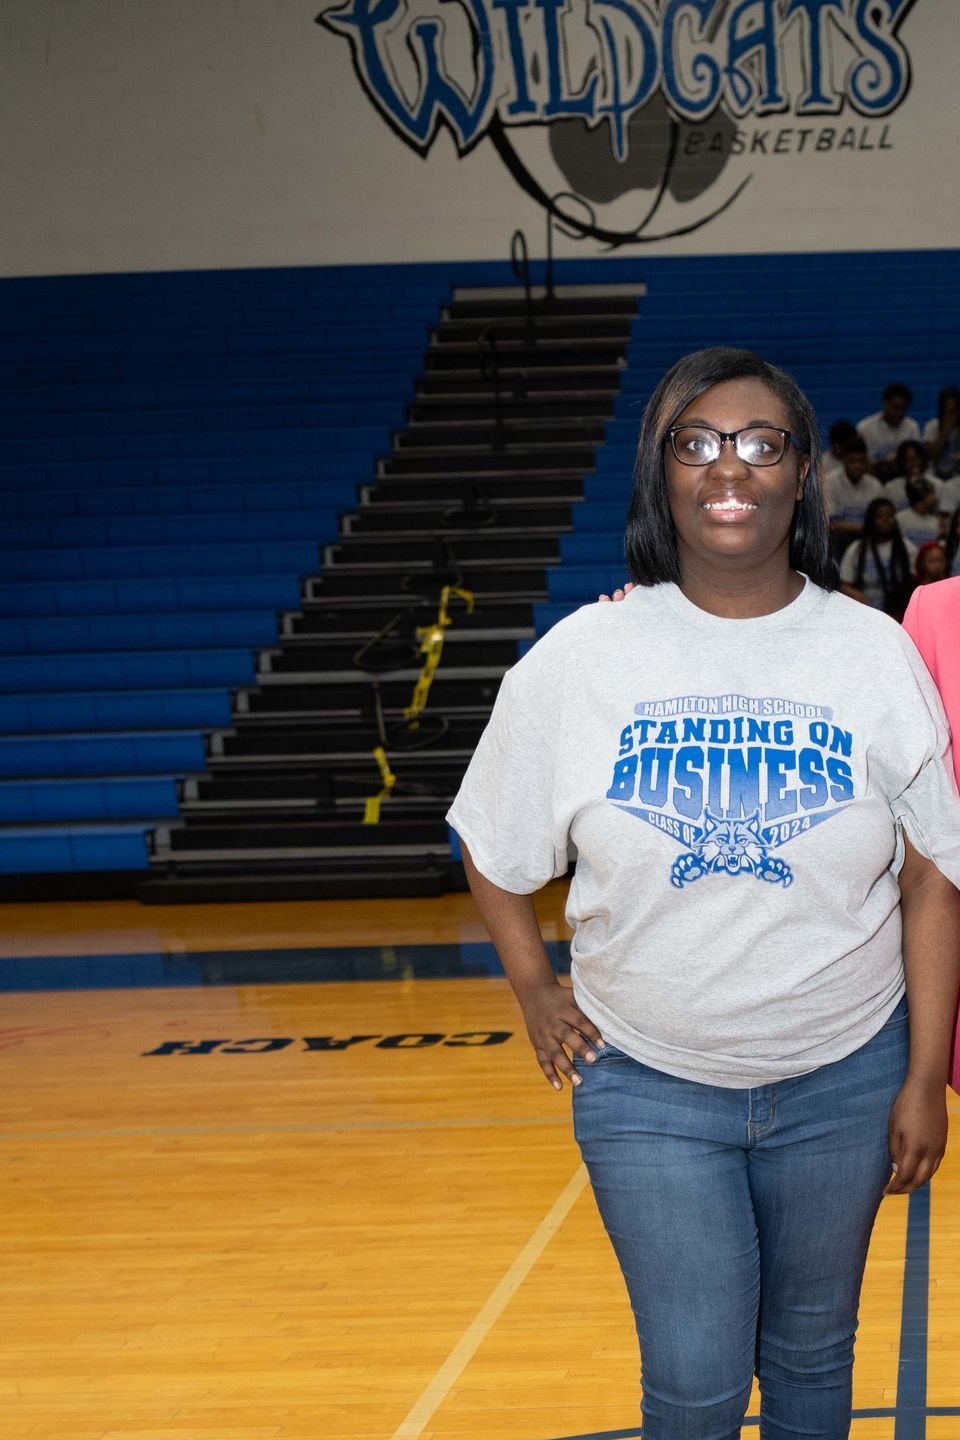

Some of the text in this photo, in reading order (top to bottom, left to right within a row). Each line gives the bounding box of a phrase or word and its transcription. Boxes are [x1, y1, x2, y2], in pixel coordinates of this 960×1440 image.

[314, 0, 912, 160] WILDCATS
[684, 124, 894, 155] BASKETBALL
[644, 695, 824, 719] HAMILTON HIGH SCHOOL
[618, 716, 854, 758] STANDING ON
[606, 745, 855, 822] BUSINESS
[648, 811, 696, 846] CLASS OF
[770, 816, 812, 847] 2024
[140, 1030, 515, 1058] COACH
